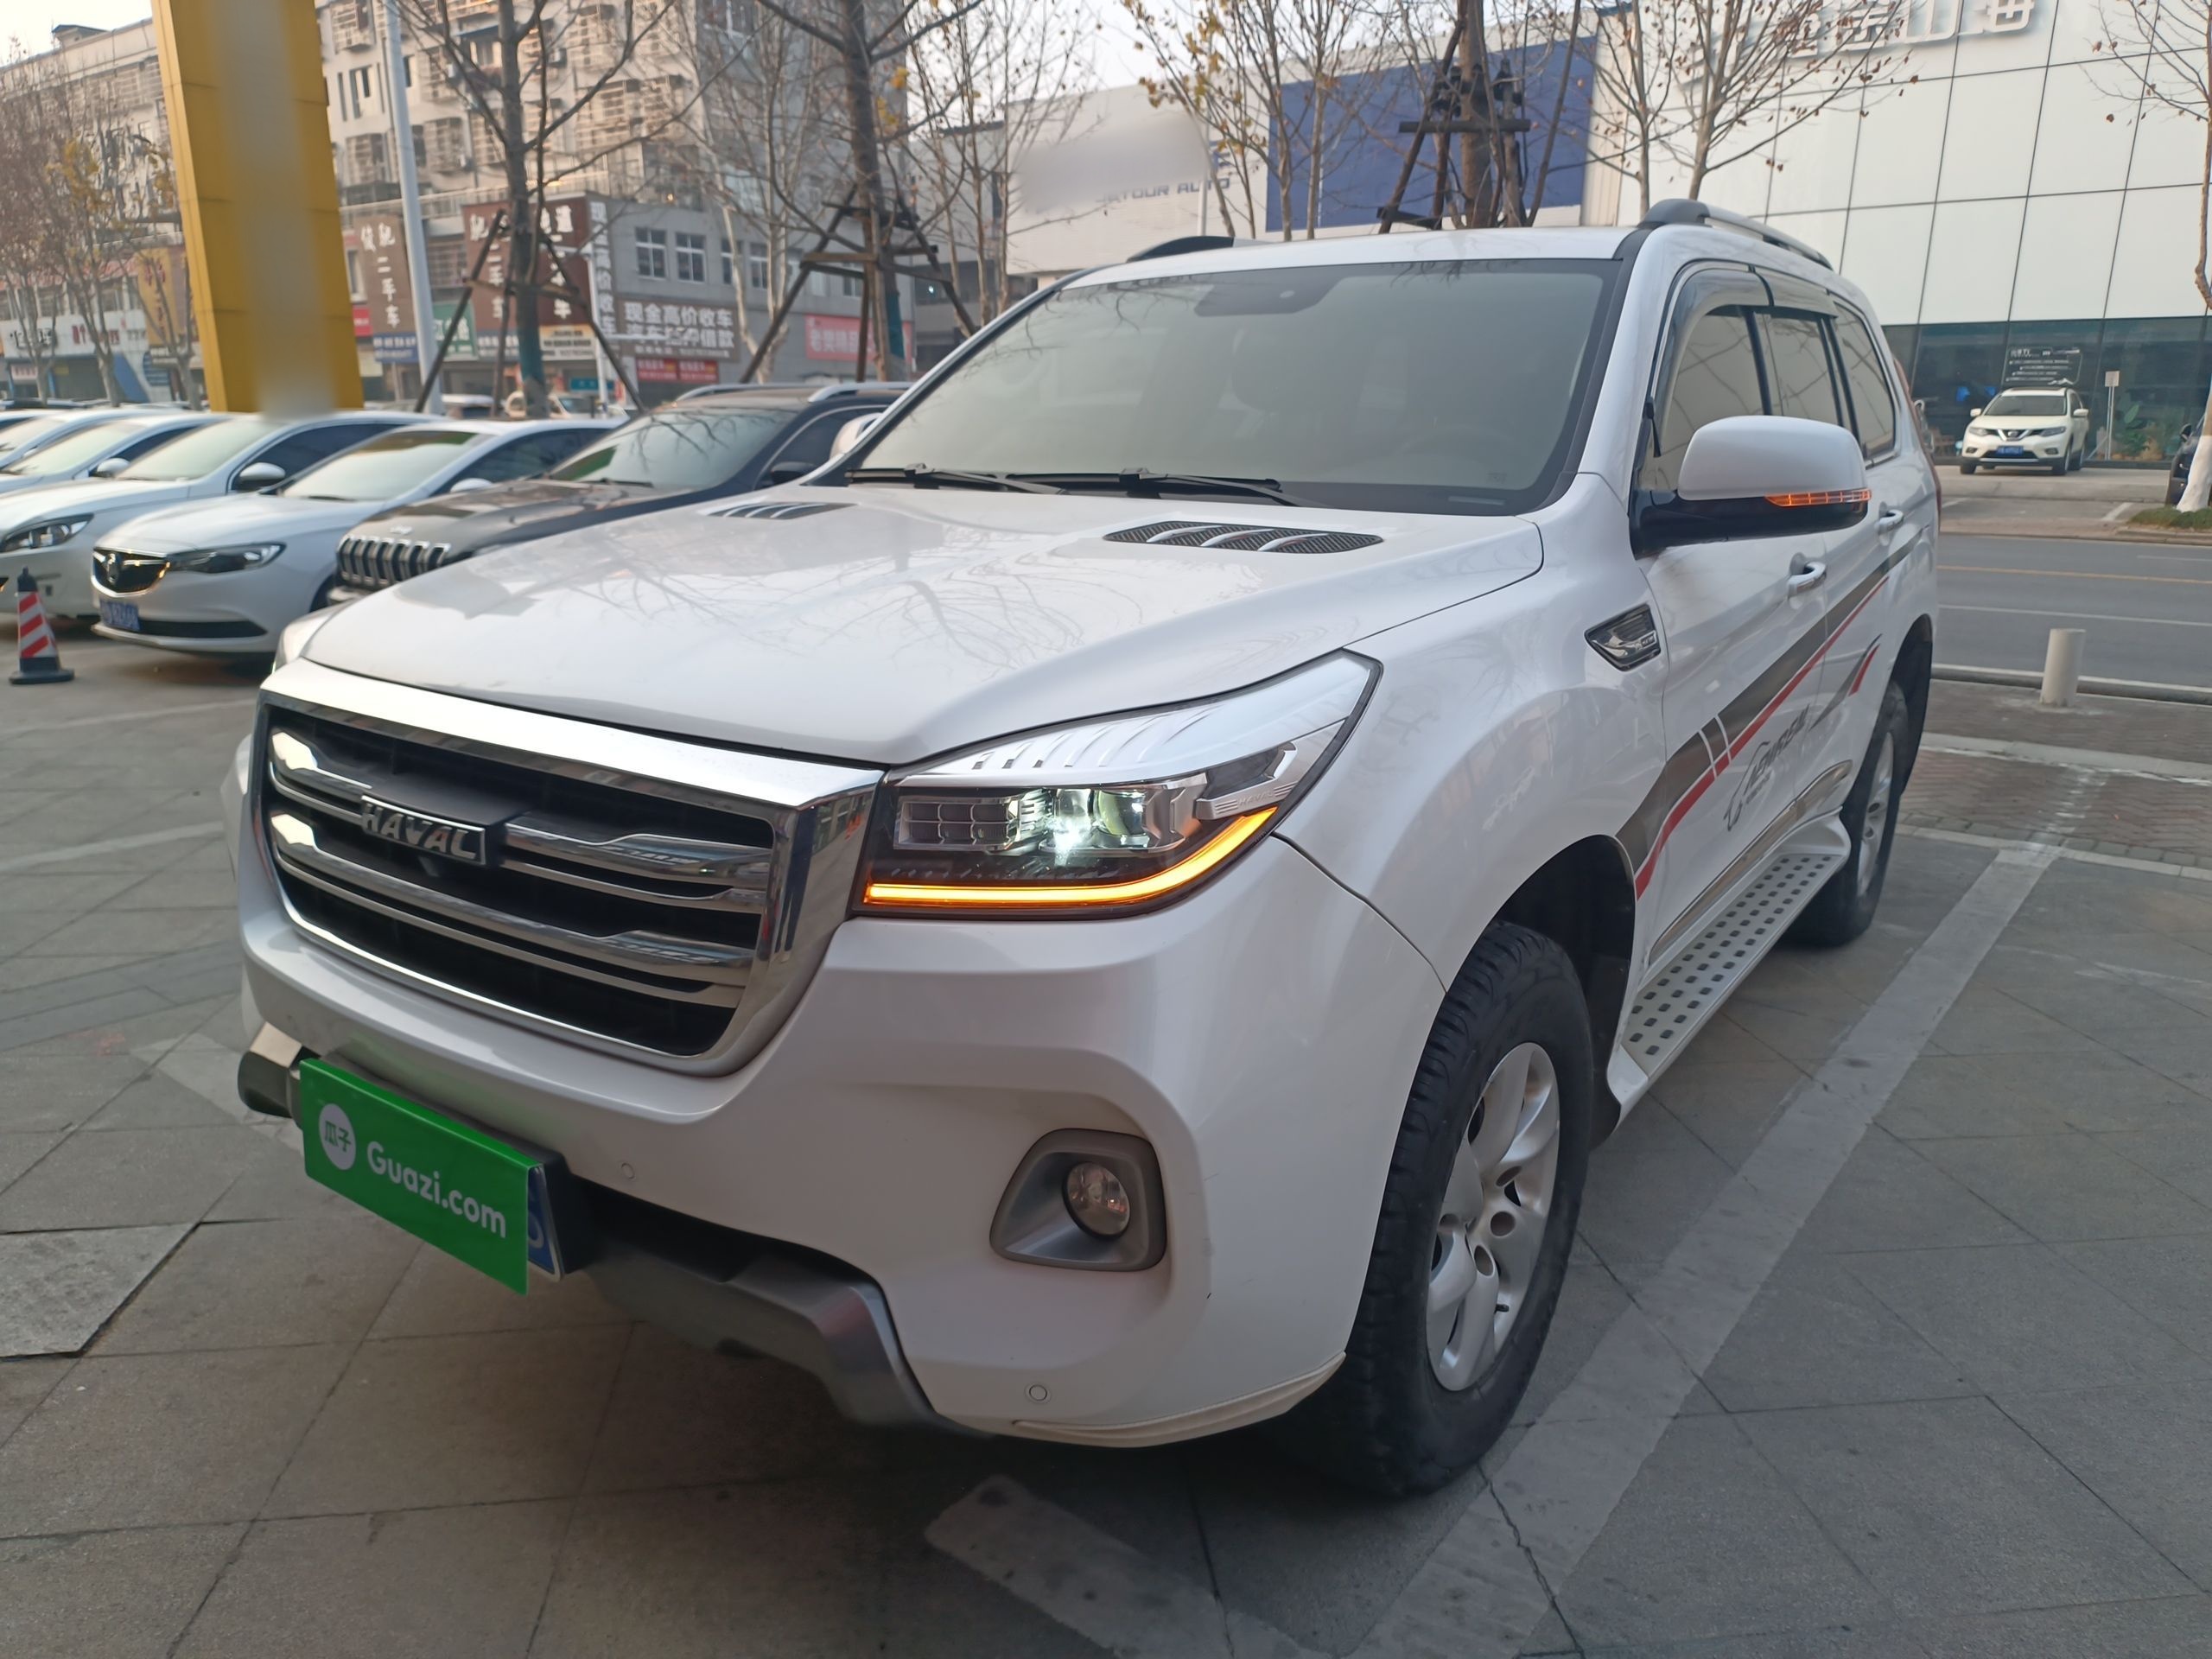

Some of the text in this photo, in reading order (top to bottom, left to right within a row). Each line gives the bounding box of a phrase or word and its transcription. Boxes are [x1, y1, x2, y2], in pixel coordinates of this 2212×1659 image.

[377, 256, 400, 329] 二手车
[625, 302, 734, 327] 现金高价收车
[361, 802, 477, 860] HAVAL
[324, 1120, 353, 1154] 瓜子
[366, 1141, 507, 1239] Guazi.com
